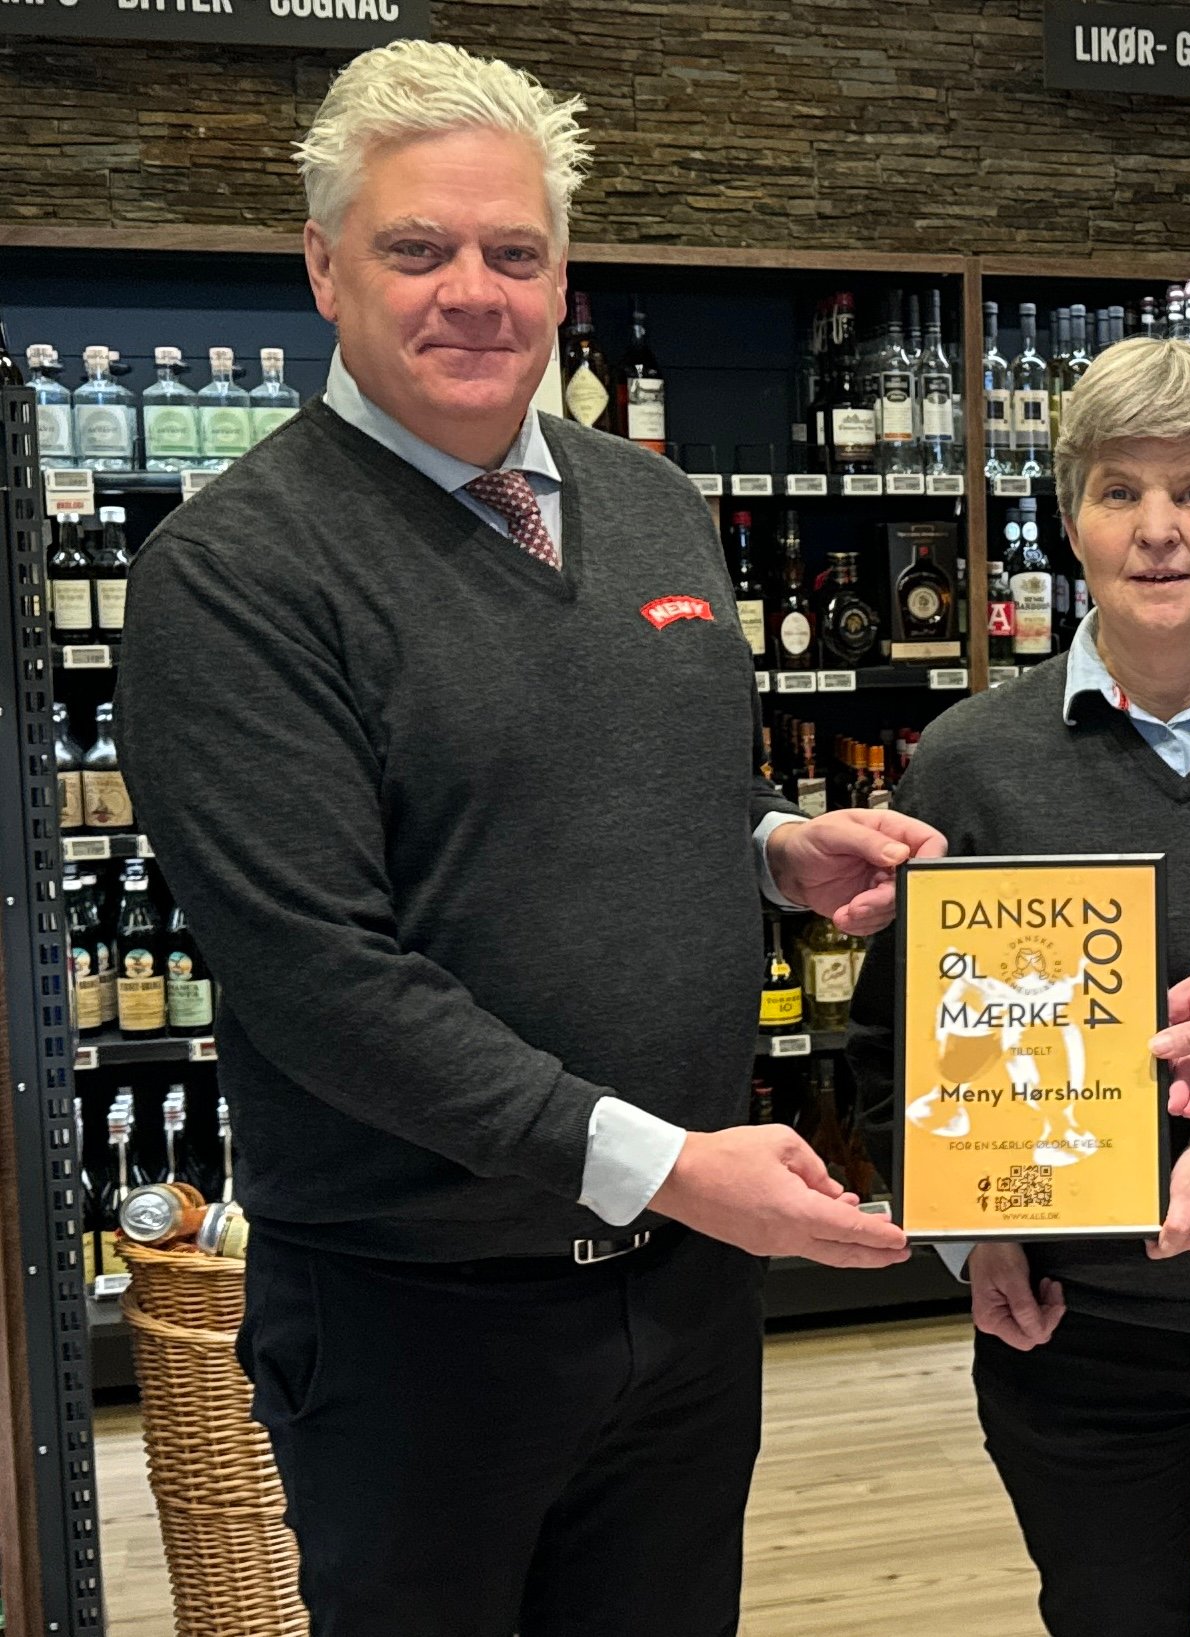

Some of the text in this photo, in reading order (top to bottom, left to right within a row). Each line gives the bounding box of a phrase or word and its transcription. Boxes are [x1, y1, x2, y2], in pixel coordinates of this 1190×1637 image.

[1075, 25, 1167, 66] LIKØR-
[941, 897, 1075, 930] DANSK
[939, 951, 987, 981] ØL
[1083, 898, 1123, 1030] 2024
[940, 1001, 1070, 1029] MÆRKE
[1010, 1046, 1053, 1056] TILDELT
[940, 1080, 1122, 1107] Meny Hørsholm
[949, 1141, 972, 1150] FOR
[974, 1141, 988, 1150] EN
[991, 1140, 1033, 1150] SÆRLIG
